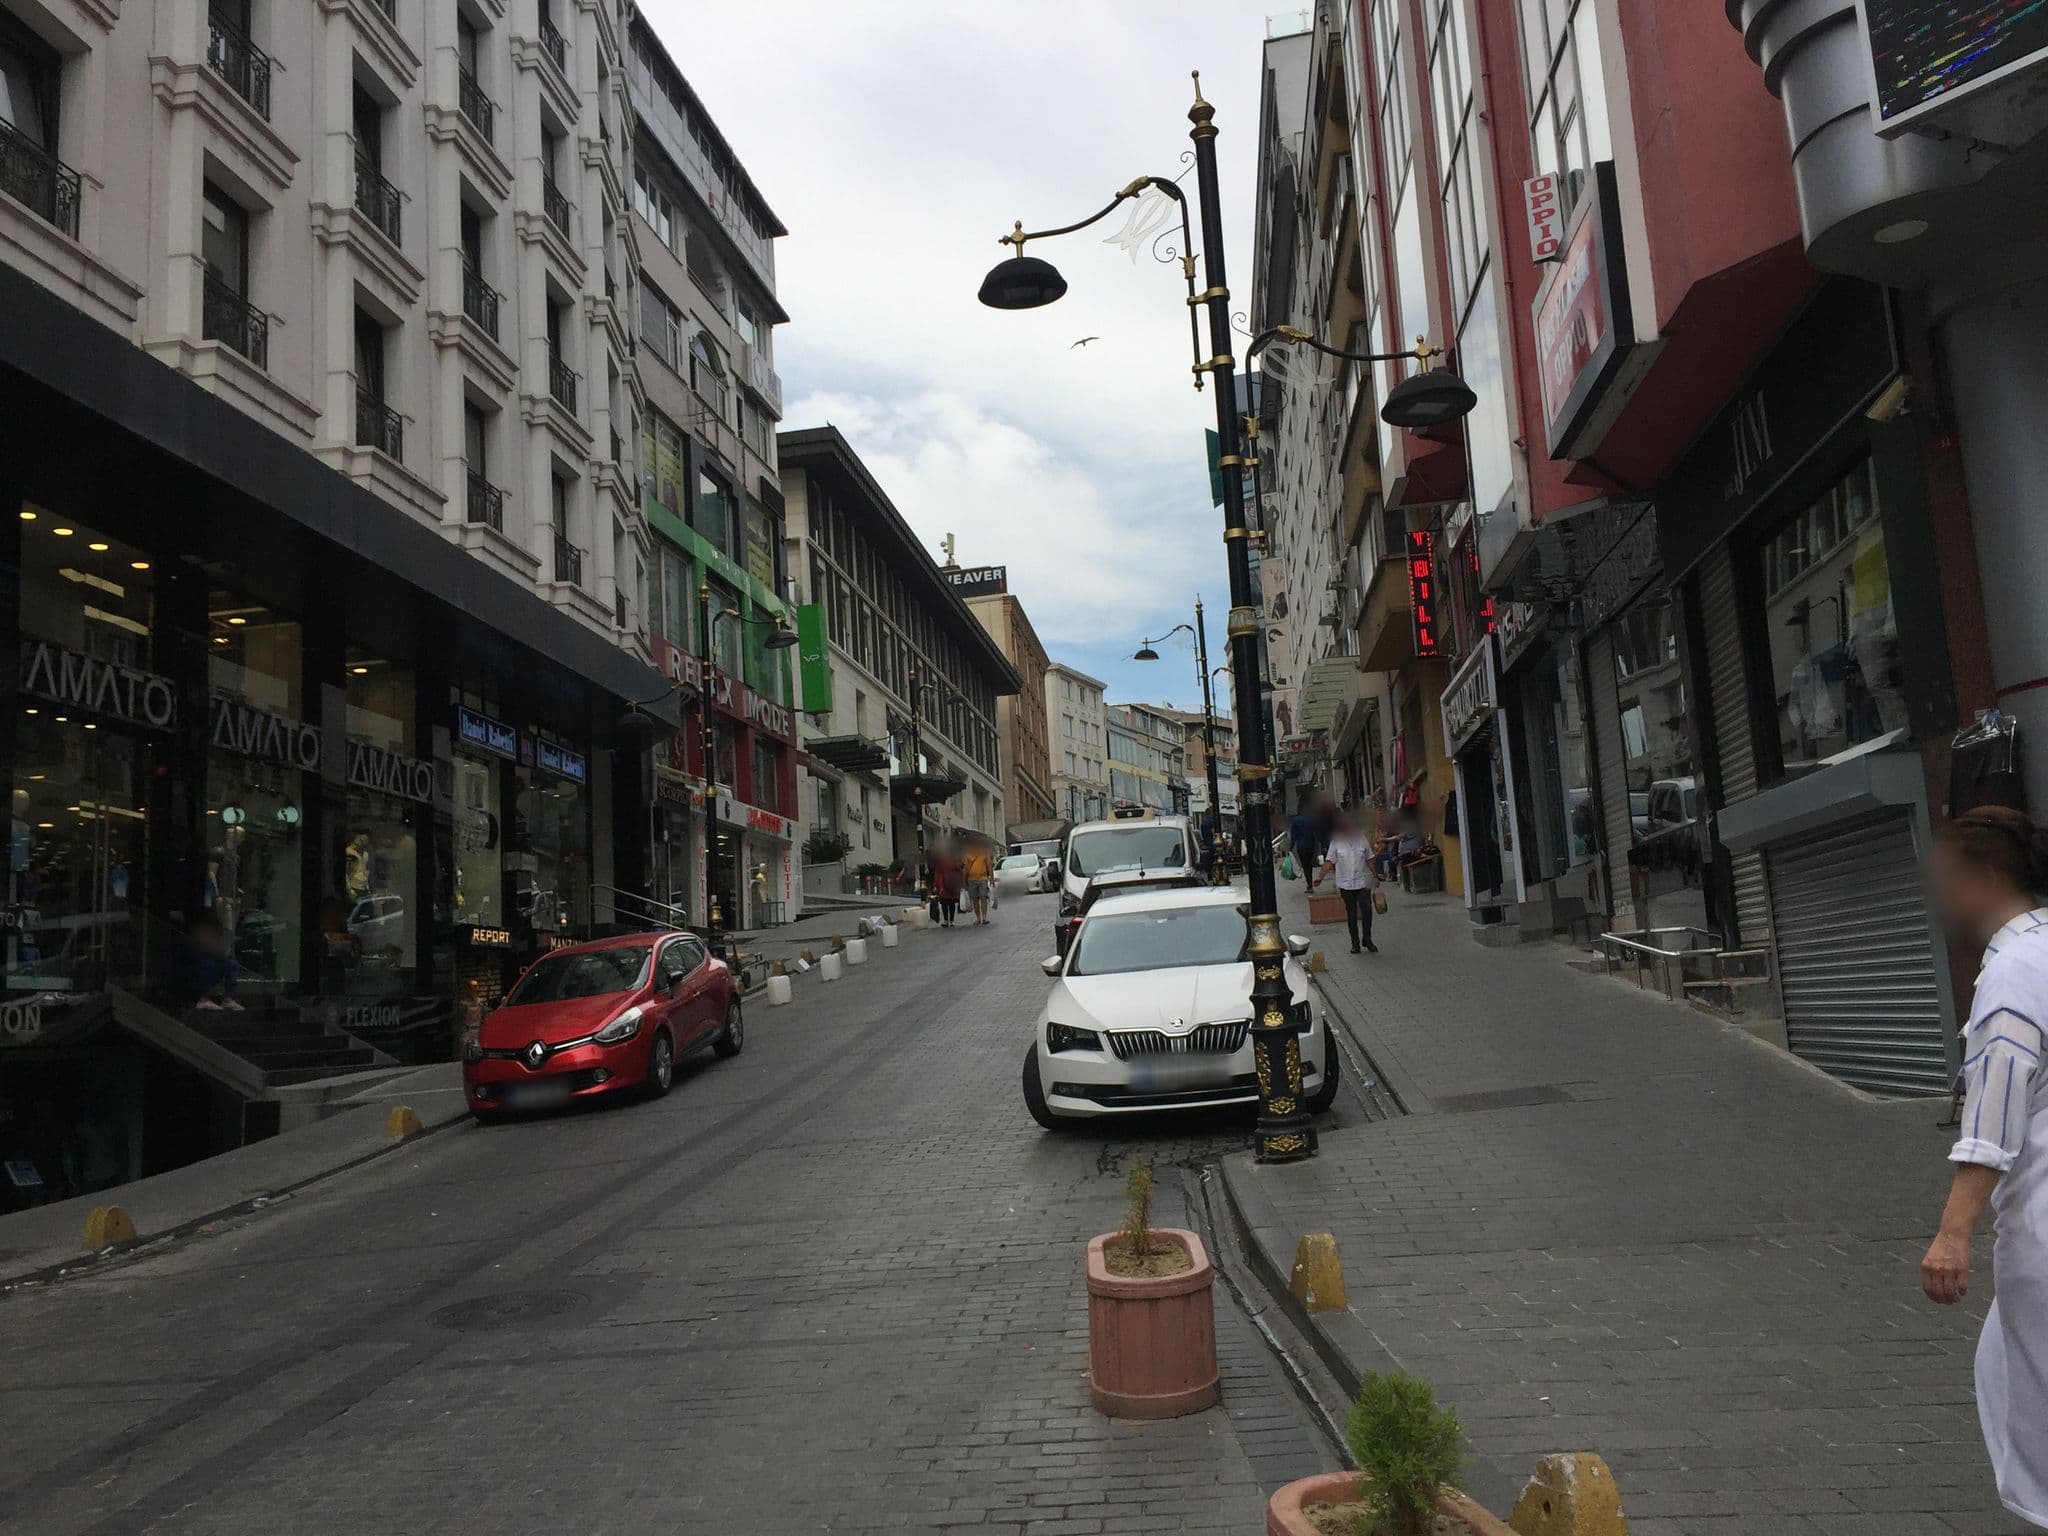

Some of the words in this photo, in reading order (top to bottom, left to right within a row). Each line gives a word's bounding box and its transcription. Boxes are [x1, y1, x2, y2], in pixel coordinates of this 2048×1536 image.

[1530, 177, 1559, 255] OPPIO
[26, 643, 174, 727] AMATO
[743, 689, 789, 736] MODE
[213, 700, 321, 768] AMATO
[350, 745, 433, 801] AMATO
[472, 928, 511, 944] REPORT
[345, 1006, 401, 1028] FLEXION
